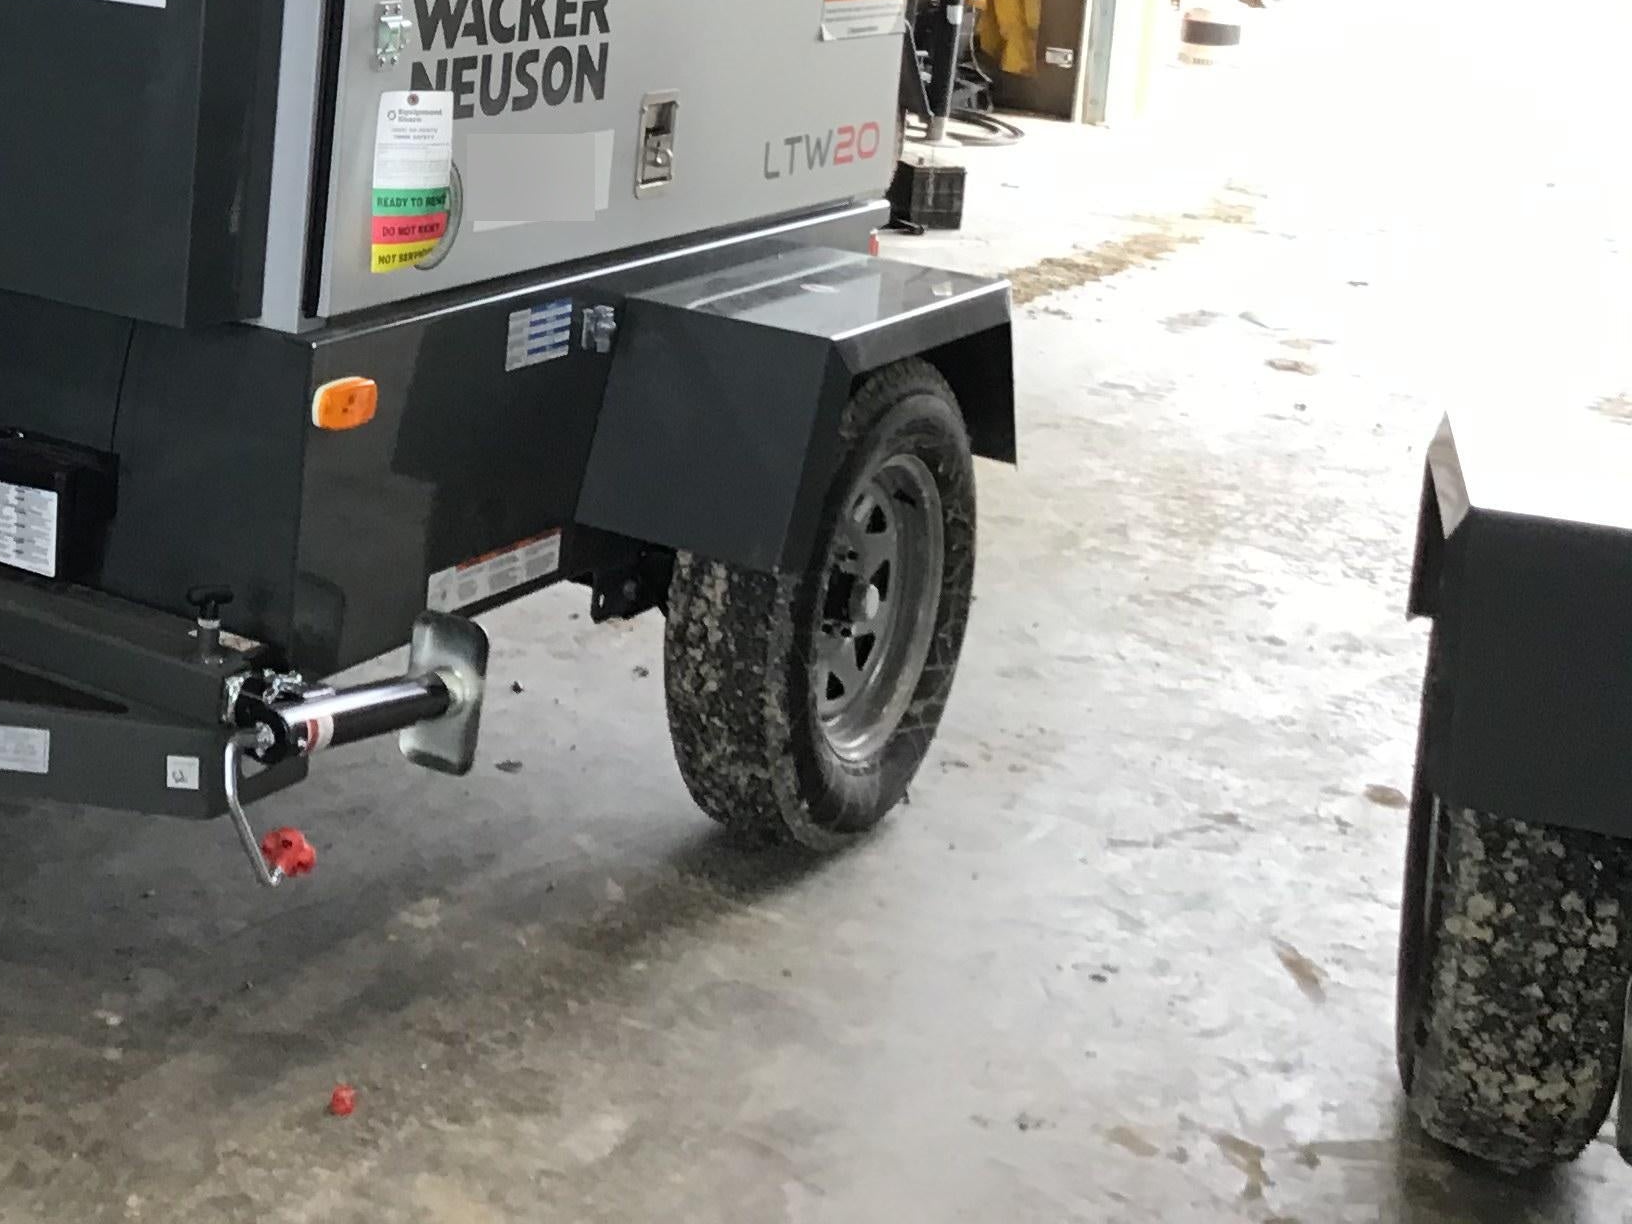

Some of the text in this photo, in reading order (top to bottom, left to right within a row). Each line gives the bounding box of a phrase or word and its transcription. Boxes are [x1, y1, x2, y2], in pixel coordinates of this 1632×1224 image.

[764, 121, 880, 180] LTW20
[377, 195, 447, 208] READY TO RENT
[382, 222, 441, 237] DO NOT RENT
[378, 254, 396, 265] NOT
